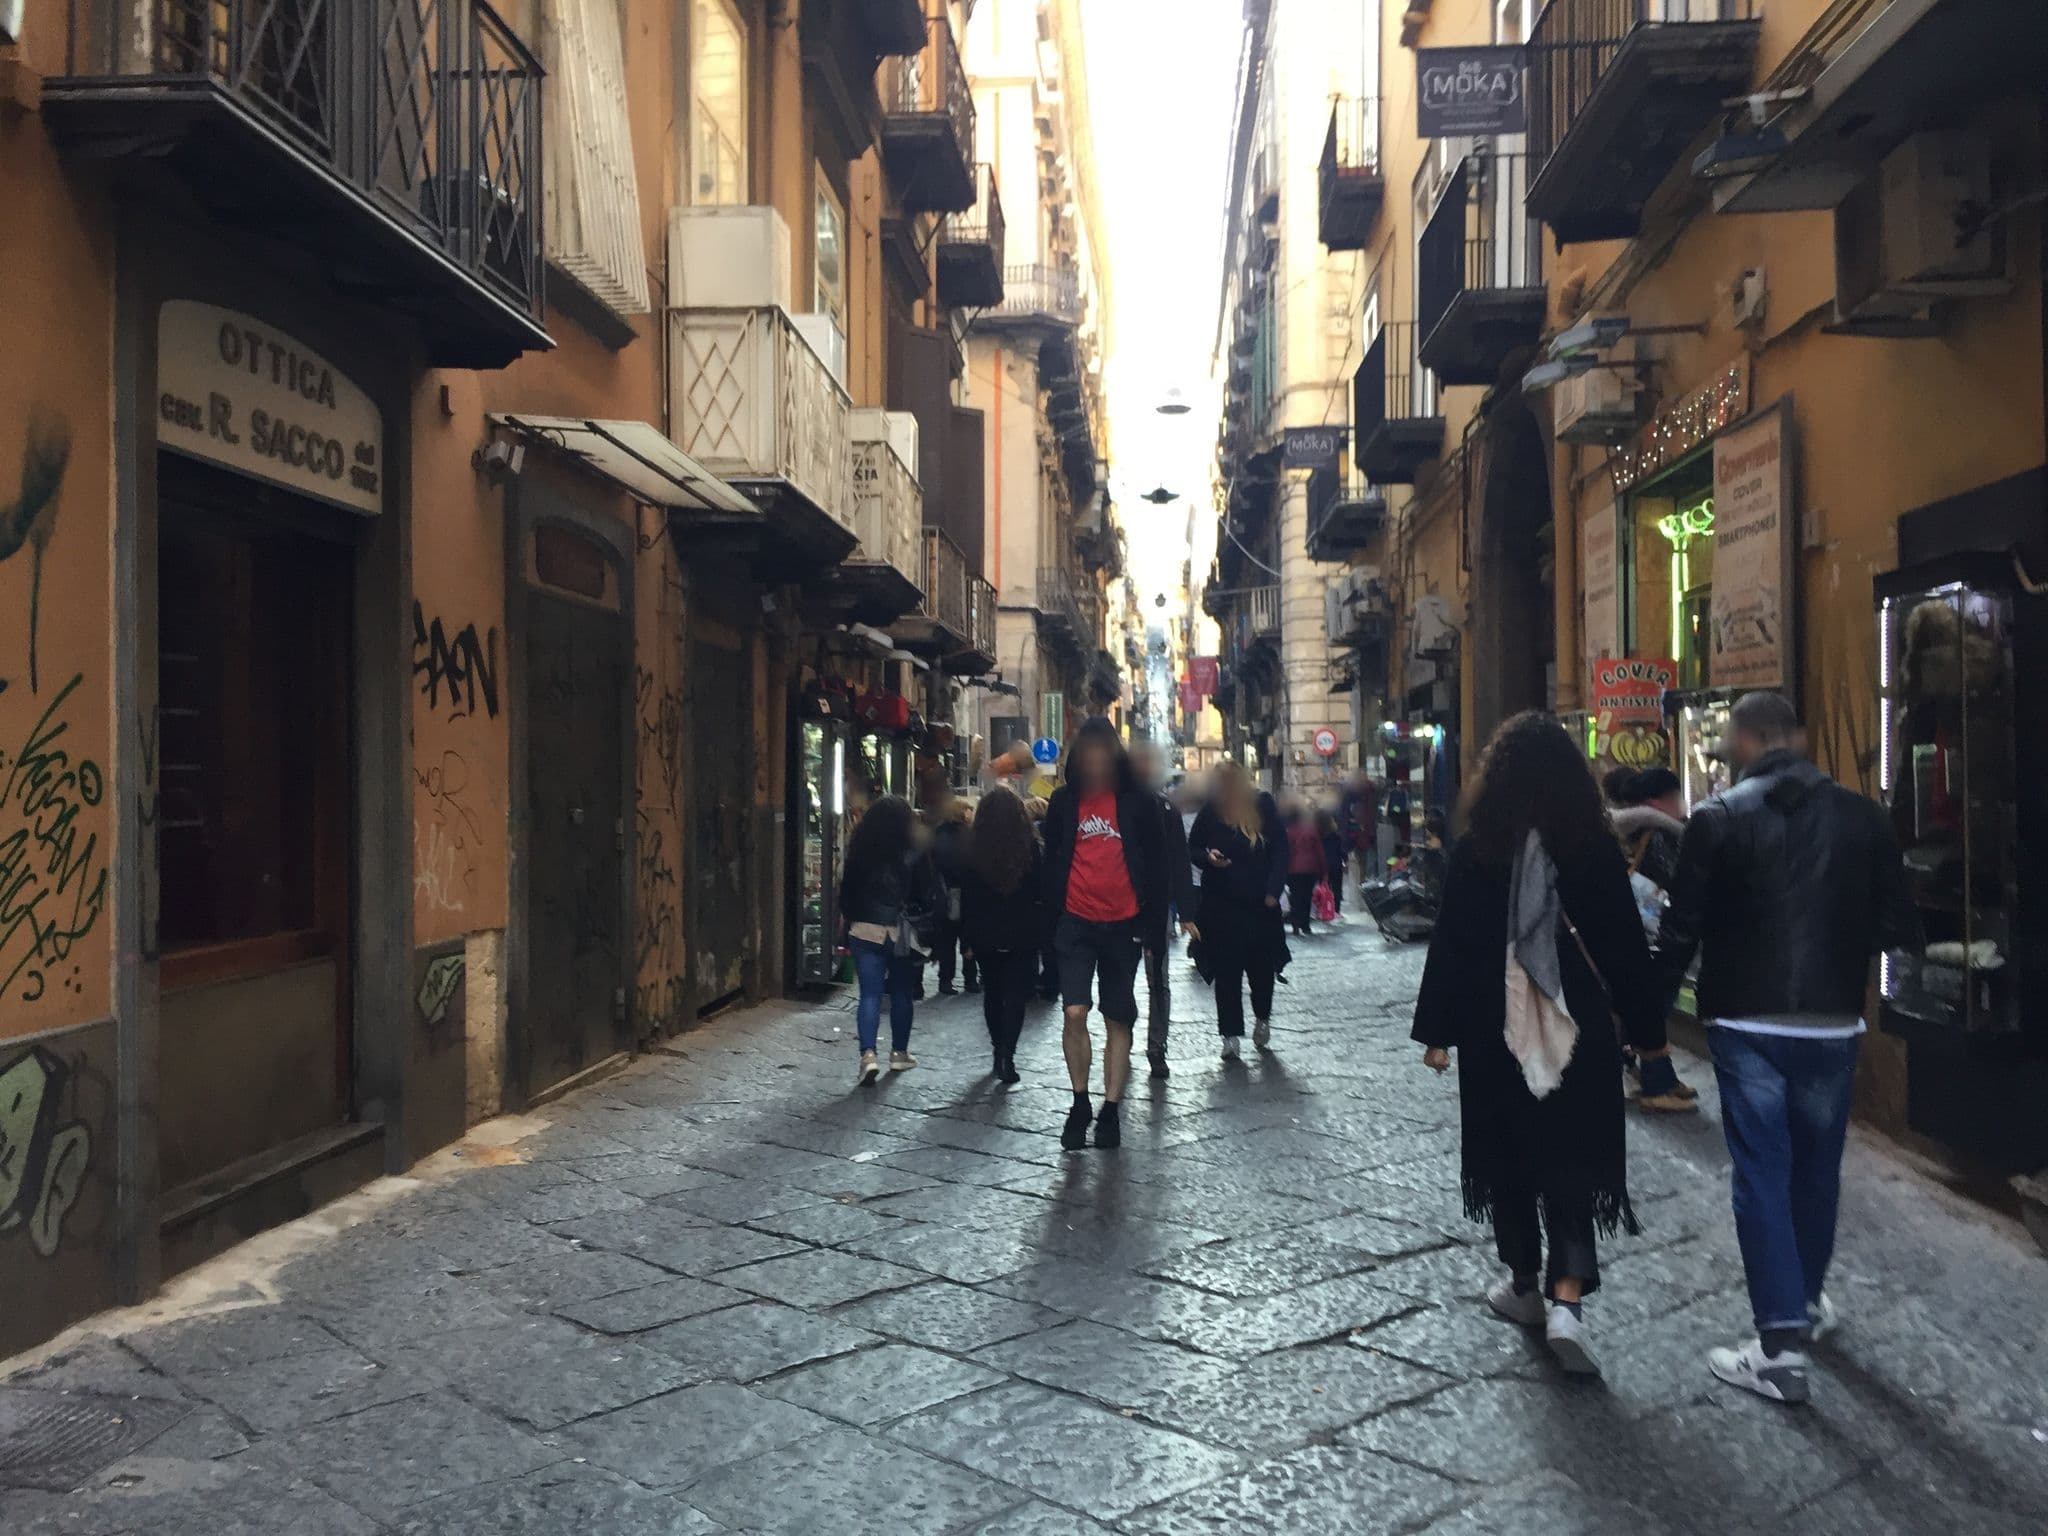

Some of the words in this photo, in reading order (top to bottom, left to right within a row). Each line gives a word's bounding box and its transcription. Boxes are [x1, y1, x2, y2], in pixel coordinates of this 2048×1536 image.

[1433, 72, 1507, 96] MOKA
[219, 321, 336, 410] OTTICA
[210, 391, 240, 445] R.
[251, 408, 344, 480] SACCO
[1292, 439, 1329, 451] MOKA
[1601, 662, 1672, 687] COVER
